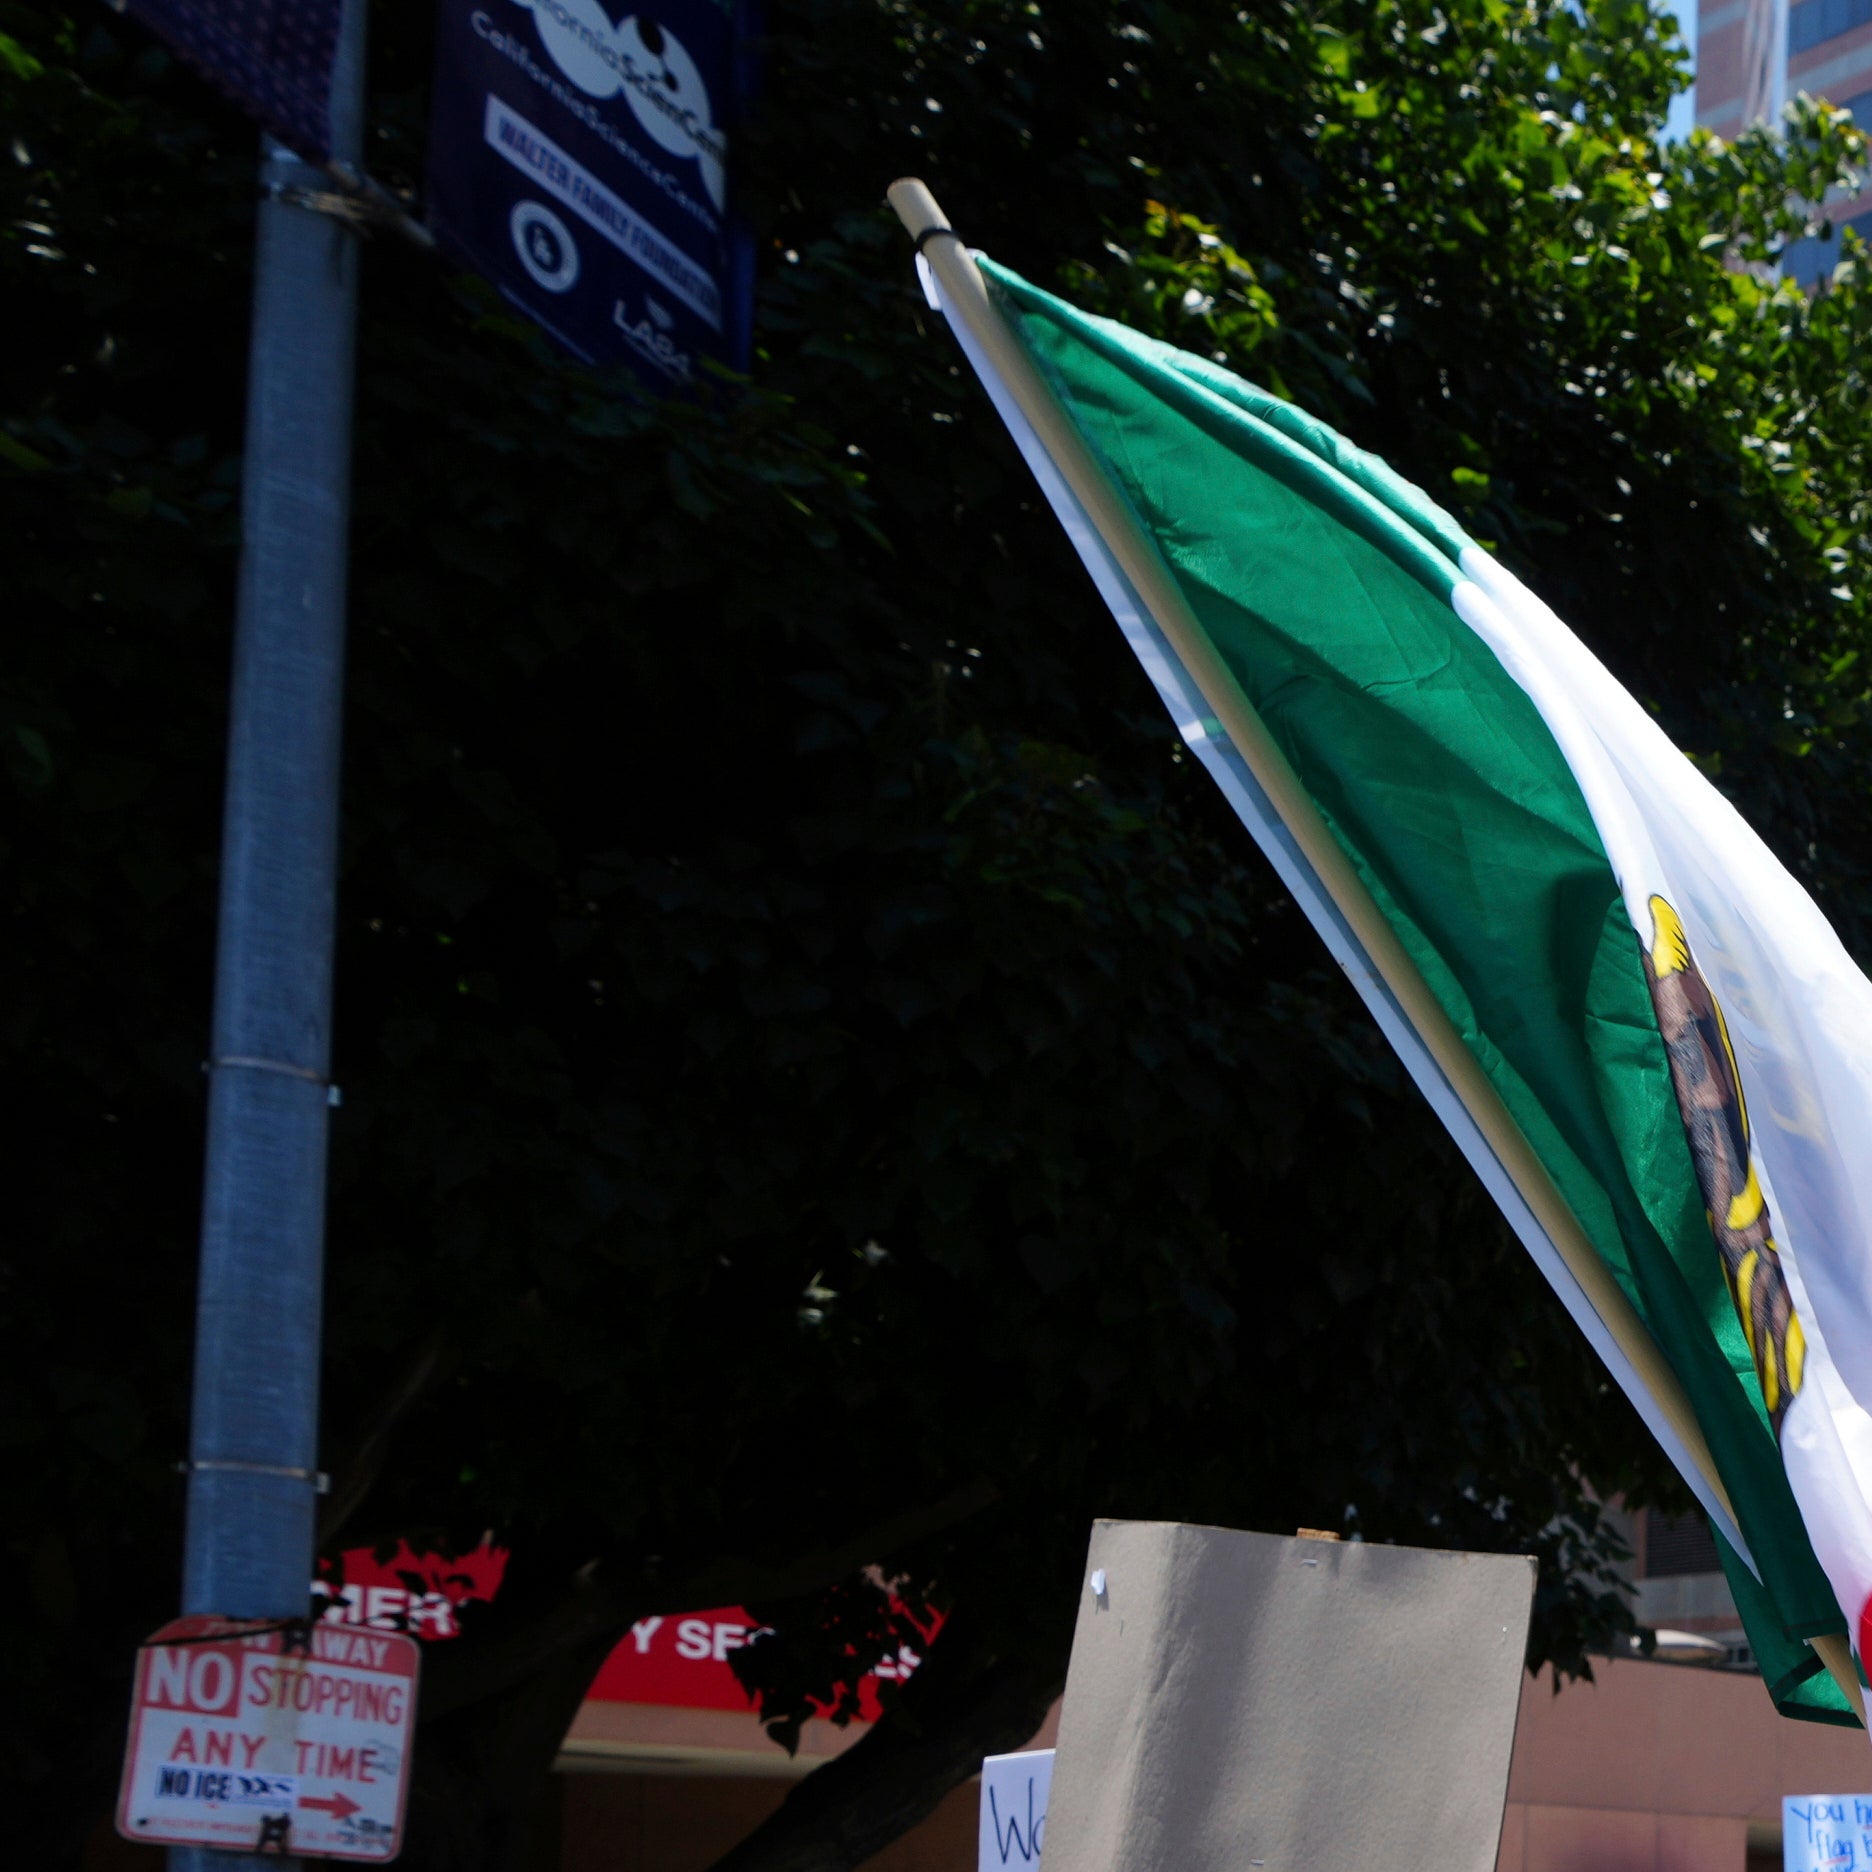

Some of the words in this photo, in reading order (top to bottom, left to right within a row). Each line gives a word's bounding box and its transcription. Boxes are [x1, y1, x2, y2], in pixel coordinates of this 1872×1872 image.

[148, 1646, 234, 1711] NO
[248, 1664, 403, 1726] STOPPING
[169, 1727, 267, 1770] ANY
[294, 1740, 378, 1784] TIME
[158, 1770, 189, 1797] NO
[195, 1774, 231, 1801] ICE
